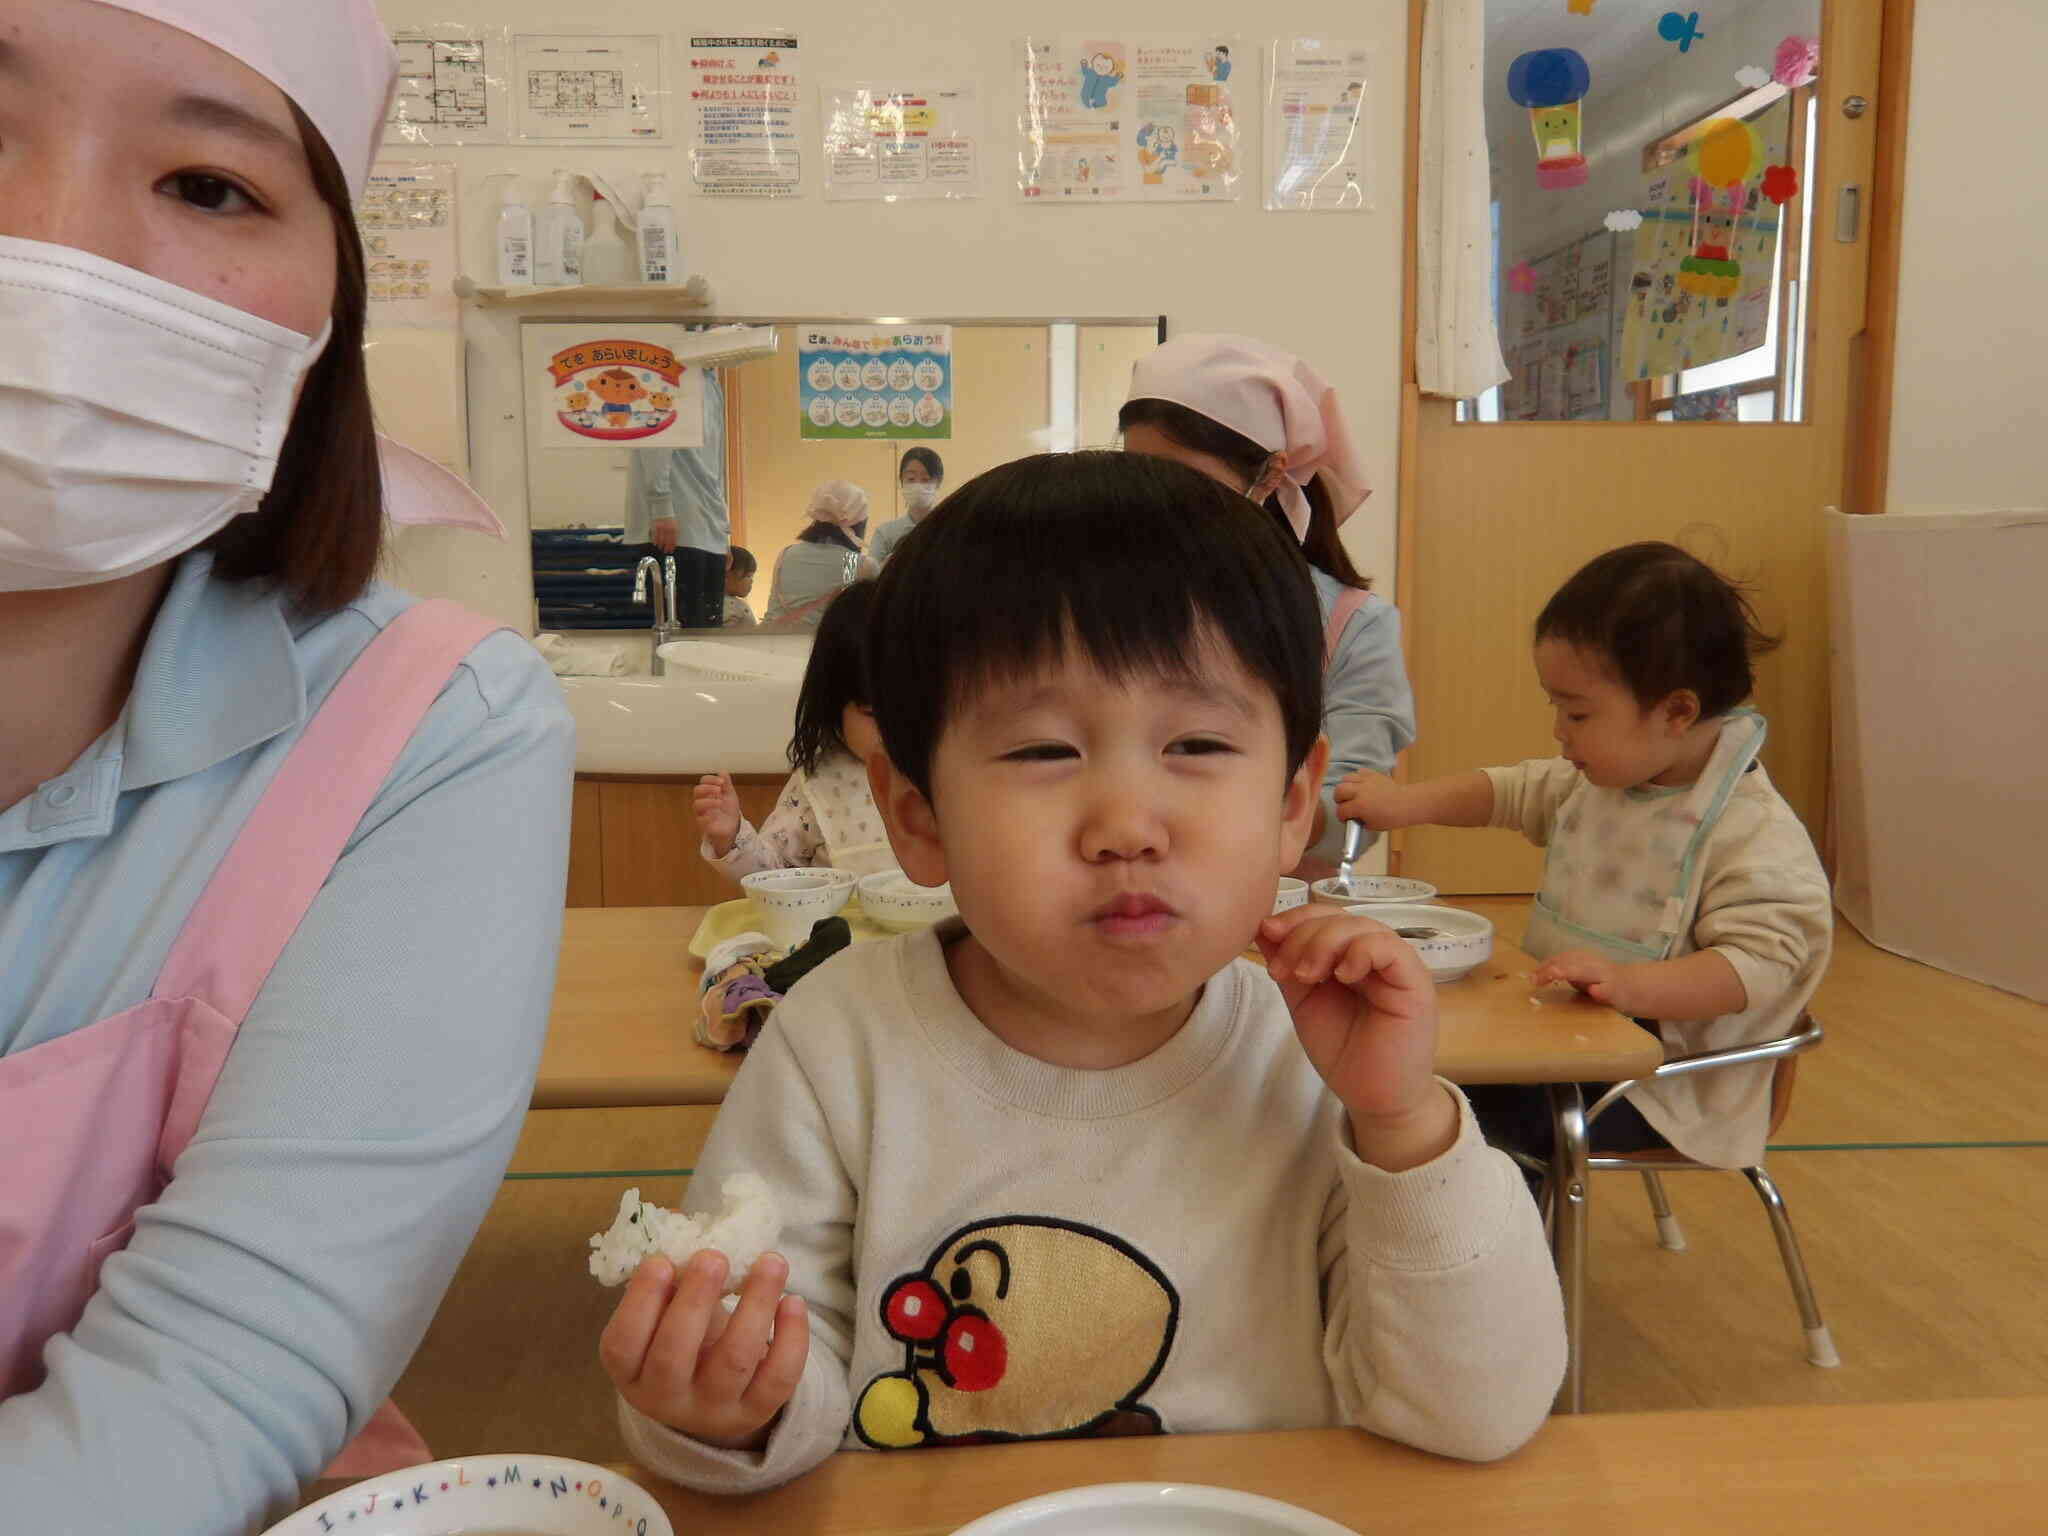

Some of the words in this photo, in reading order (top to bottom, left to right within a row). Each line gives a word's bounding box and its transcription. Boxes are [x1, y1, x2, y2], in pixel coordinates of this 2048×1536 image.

[560, 351, 586, 369] てを
[591, 347, 673, 369] あらいましょう
[318, 1511, 334, 1532] I
[365, 1493, 379, 1515] J
[412, 1482, 429, 1505] K
[459, 1464, 472, 1486] L
[504, 1464, 521, 1485] M
[550, 1475, 568, 1499] N
